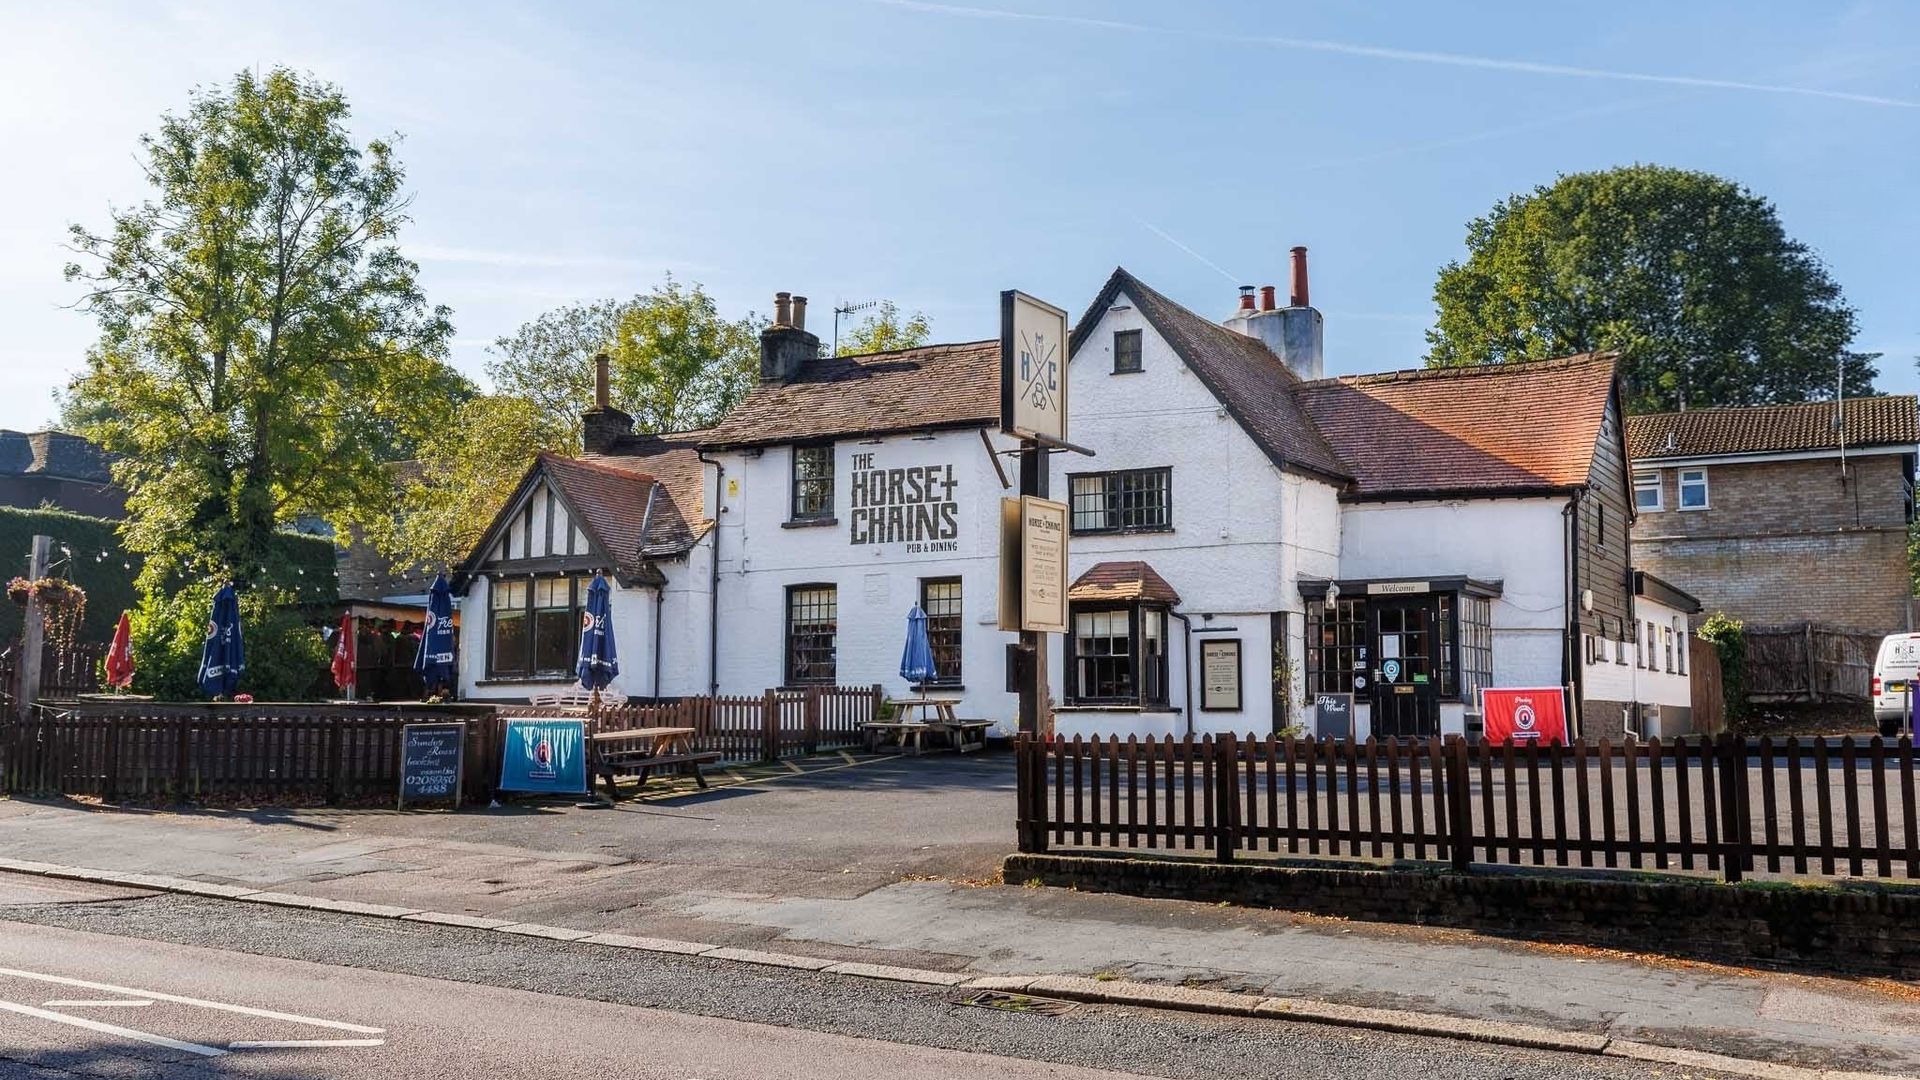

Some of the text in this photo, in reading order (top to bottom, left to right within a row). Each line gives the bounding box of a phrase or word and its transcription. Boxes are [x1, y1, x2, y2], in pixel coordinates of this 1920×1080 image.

[1021, 351, 1056, 391] H C
[851, 453, 875, 470] THE
[850, 502, 958, 545] CHAINS
[906, 541, 958, 553] PUB & DINING
[1381, 584, 1416, 593] Welcome
[1317, 696, 1336, 705] This
[1324, 703, 1346, 713] Week
[418, 785, 447, 793] 4488
